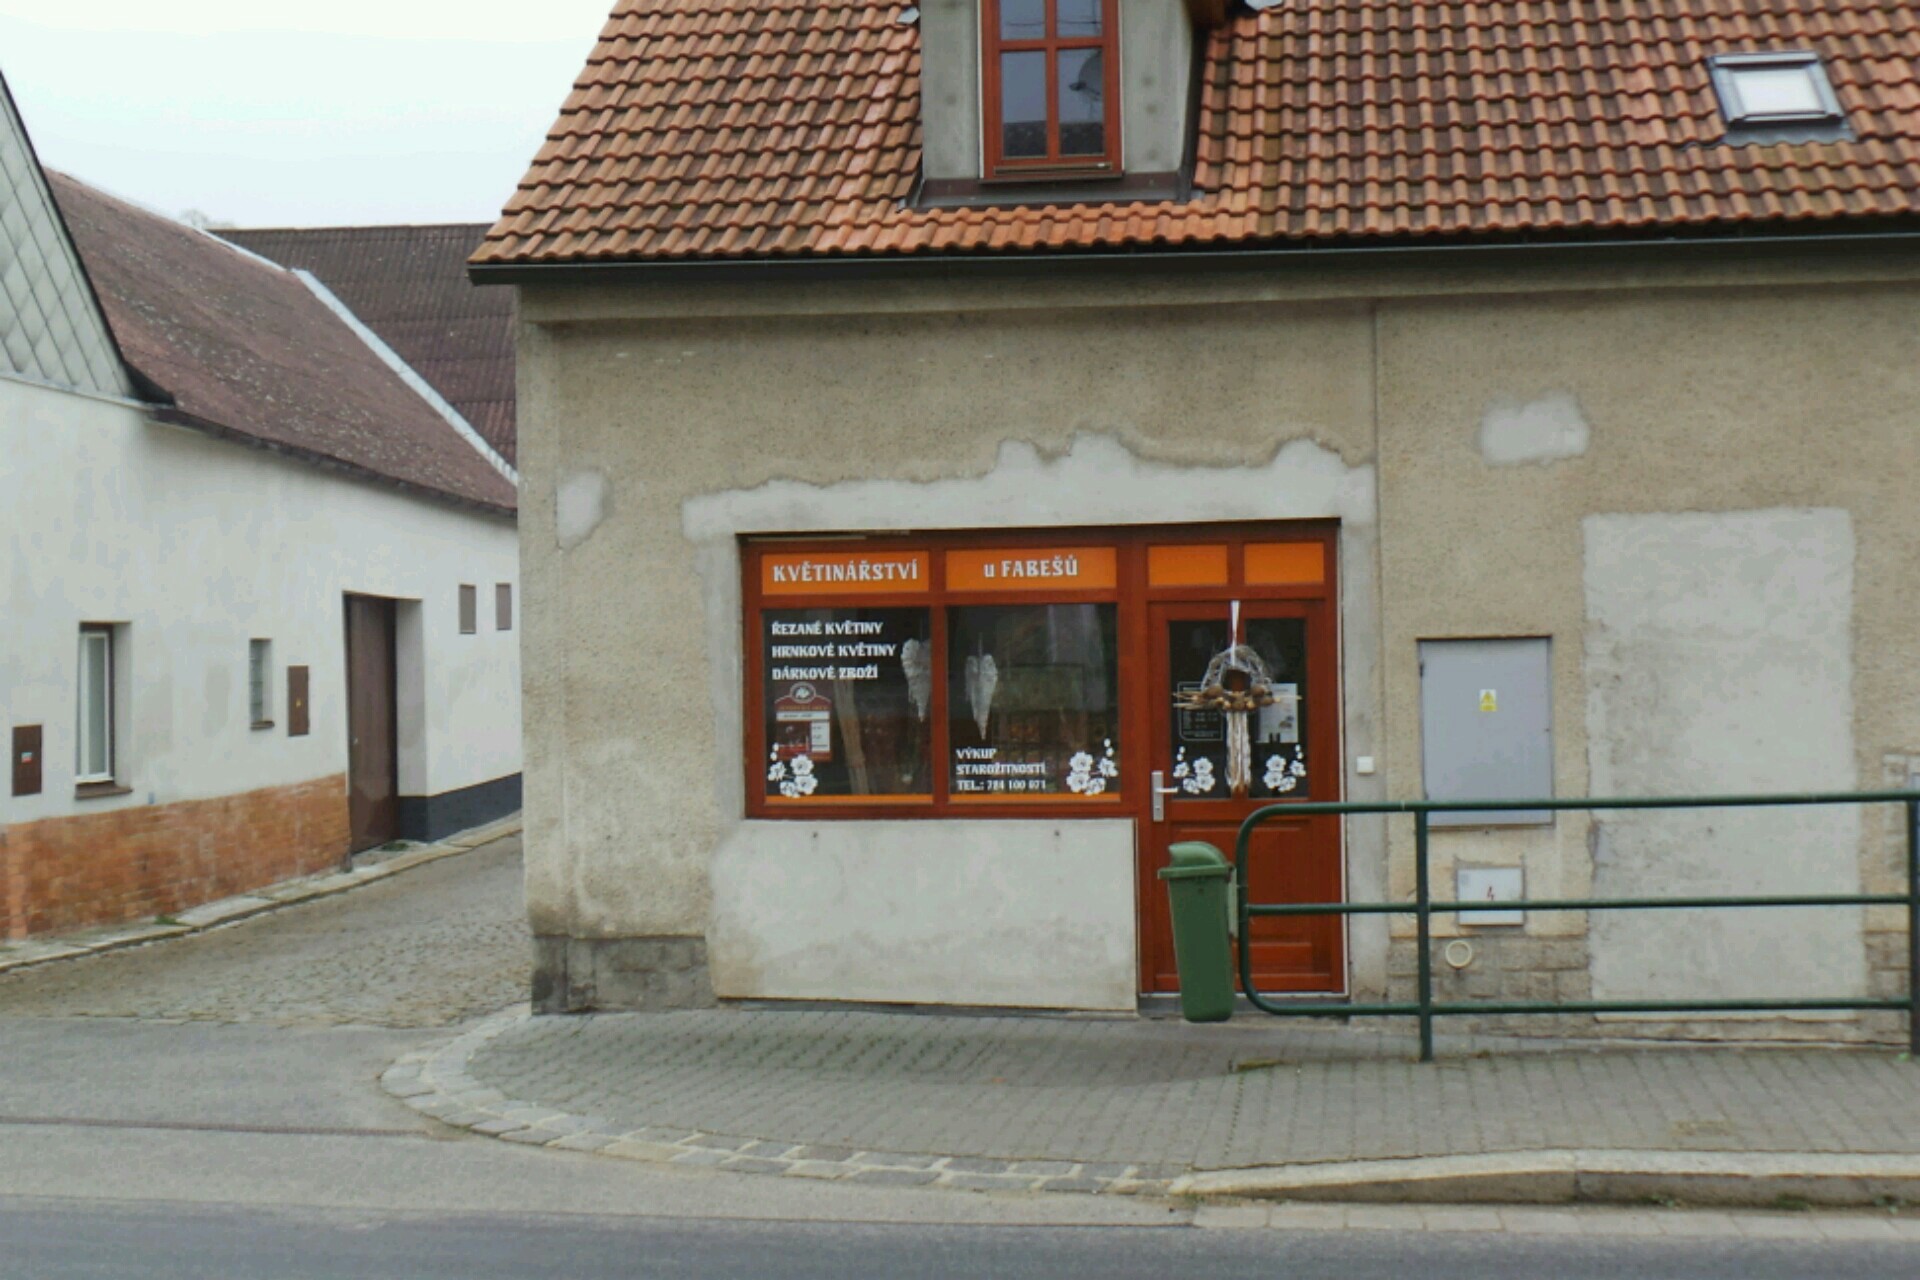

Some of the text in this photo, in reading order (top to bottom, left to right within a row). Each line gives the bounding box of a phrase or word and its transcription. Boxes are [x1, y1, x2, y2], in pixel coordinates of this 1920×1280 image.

[773, 559, 918, 582] KVĚTINÁŘSTVÍ
[1001, 556, 1078, 578] FABEŠŮ
[772, 620, 883, 635] ŘEZANÉ KVĚTINY
[772, 642, 896, 658] HRNKOVÉ KVĚTINY
[772, 664, 878, 680] DÁRKOVÉ ZBOŽÍ
[956, 747, 997, 759] VÝKUP
